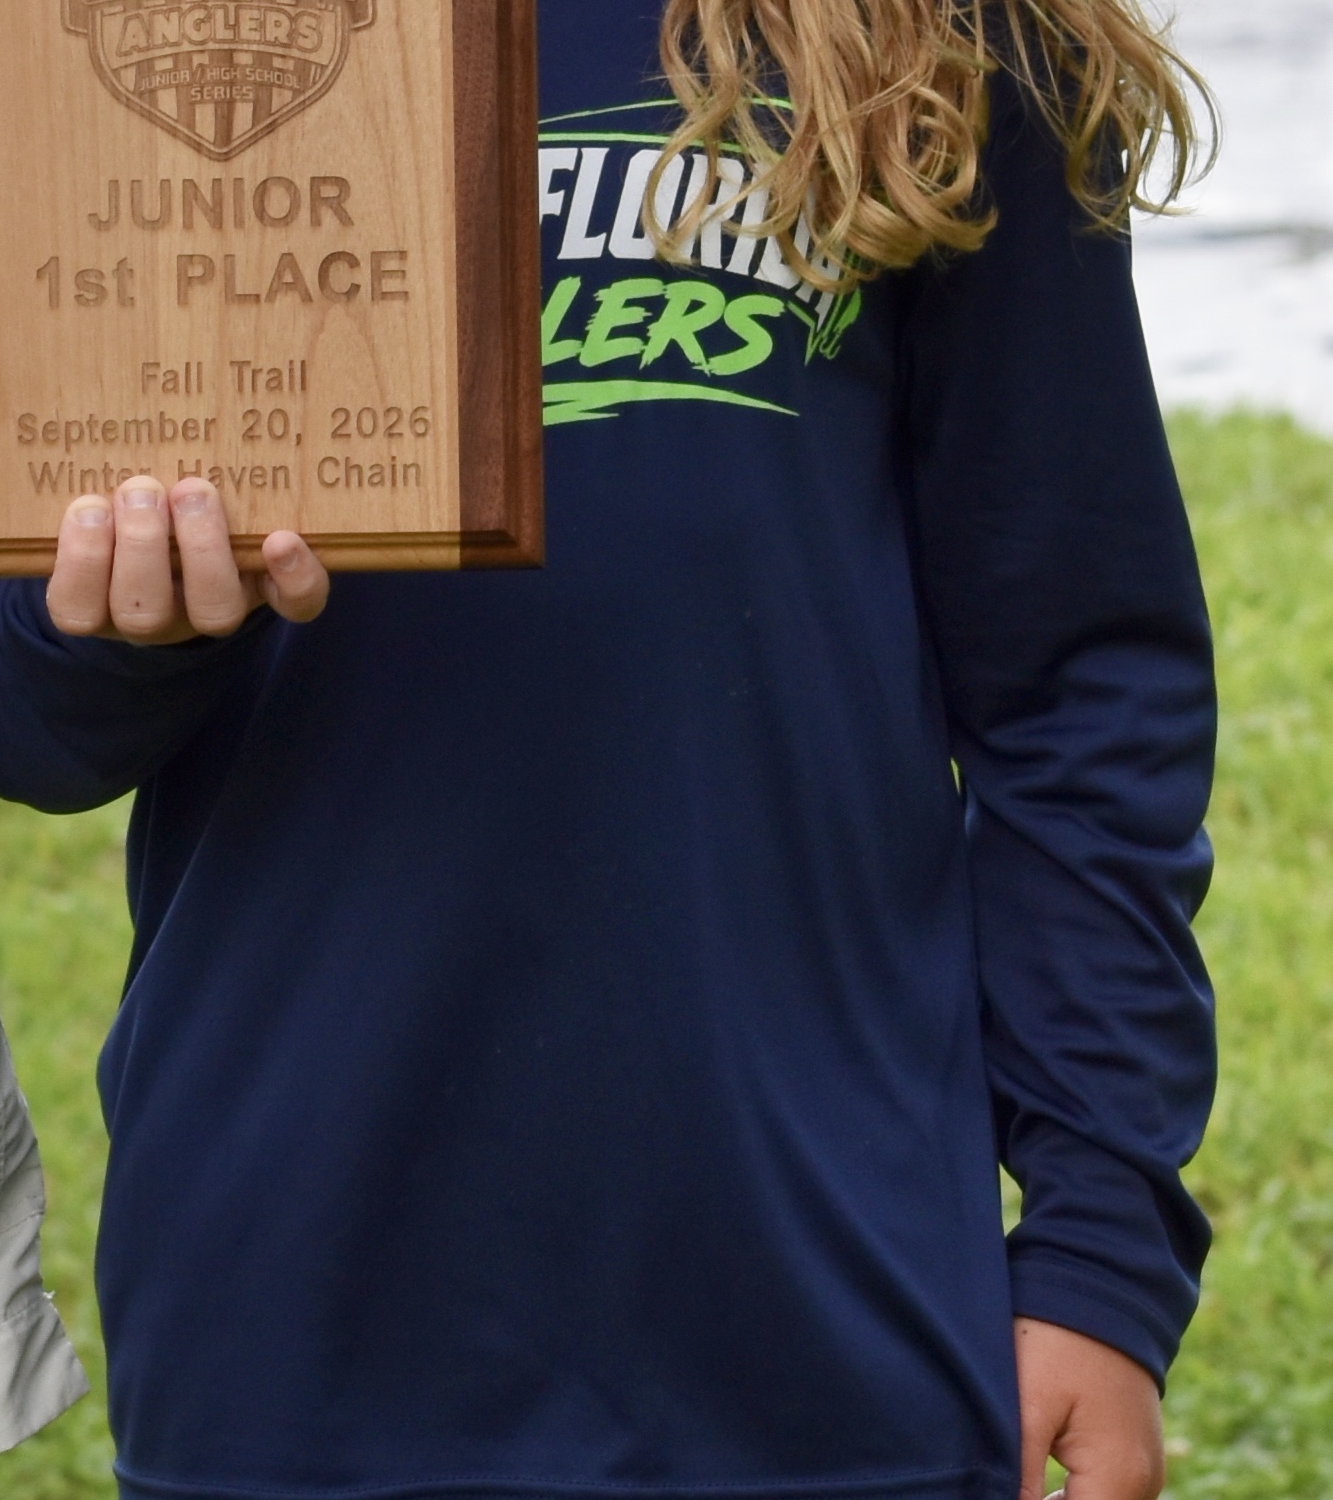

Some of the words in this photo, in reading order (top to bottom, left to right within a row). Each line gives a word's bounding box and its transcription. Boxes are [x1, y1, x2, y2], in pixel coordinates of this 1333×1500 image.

[117, 4, 323, 56] ANGLERS
[140, 69, 190, 91] JUNIOR
[207, 67, 241, 81] HIGH
[245, 67, 302, 89] SCHOOL
[190, 86, 254, 101] SERIES
[87, 175, 355, 231] JUNIOR
[36, 255, 135, 308] 1st
[176, 250, 410, 306] PLACE
[141, 361, 203, 394] Fall
[229, 359, 307, 393] Trail
[16, 410, 216, 453] September
[240, 407, 303, 447] 20,
[330, 405, 431, 439] 2026
[176, 458, 290, 493] Haven
[317, 455, 422, 489] Chain
